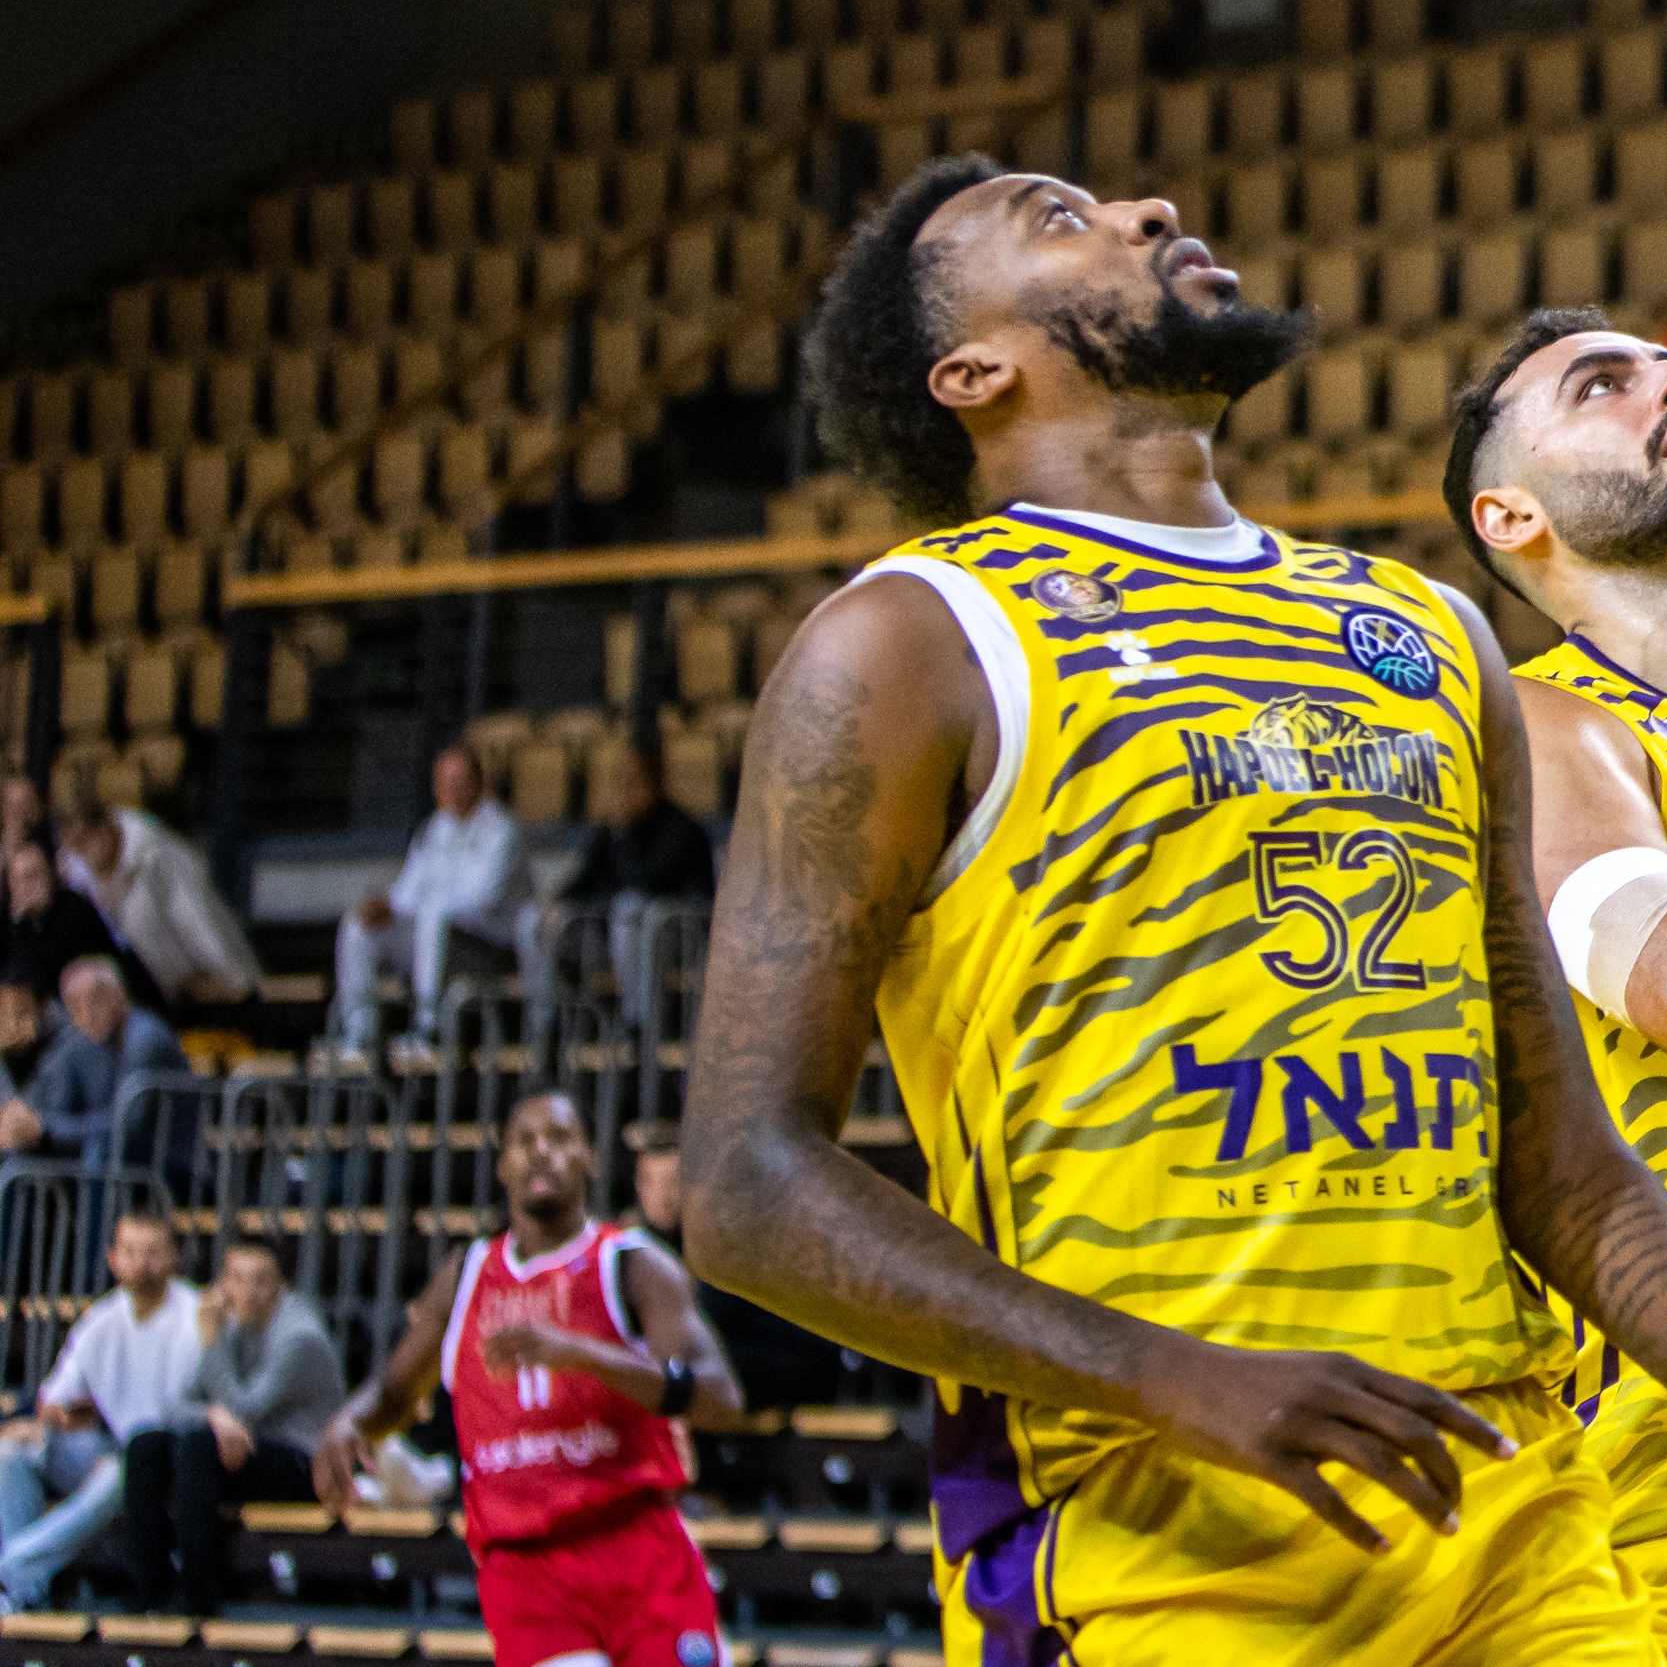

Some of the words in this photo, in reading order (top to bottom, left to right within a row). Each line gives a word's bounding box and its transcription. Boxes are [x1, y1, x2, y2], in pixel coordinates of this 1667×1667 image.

[1248, 828, 1427, 991] 52
[1170, 1043, 1489, 1162] תנאל
[1217, 1175, 1414, 1209] NETANEL
